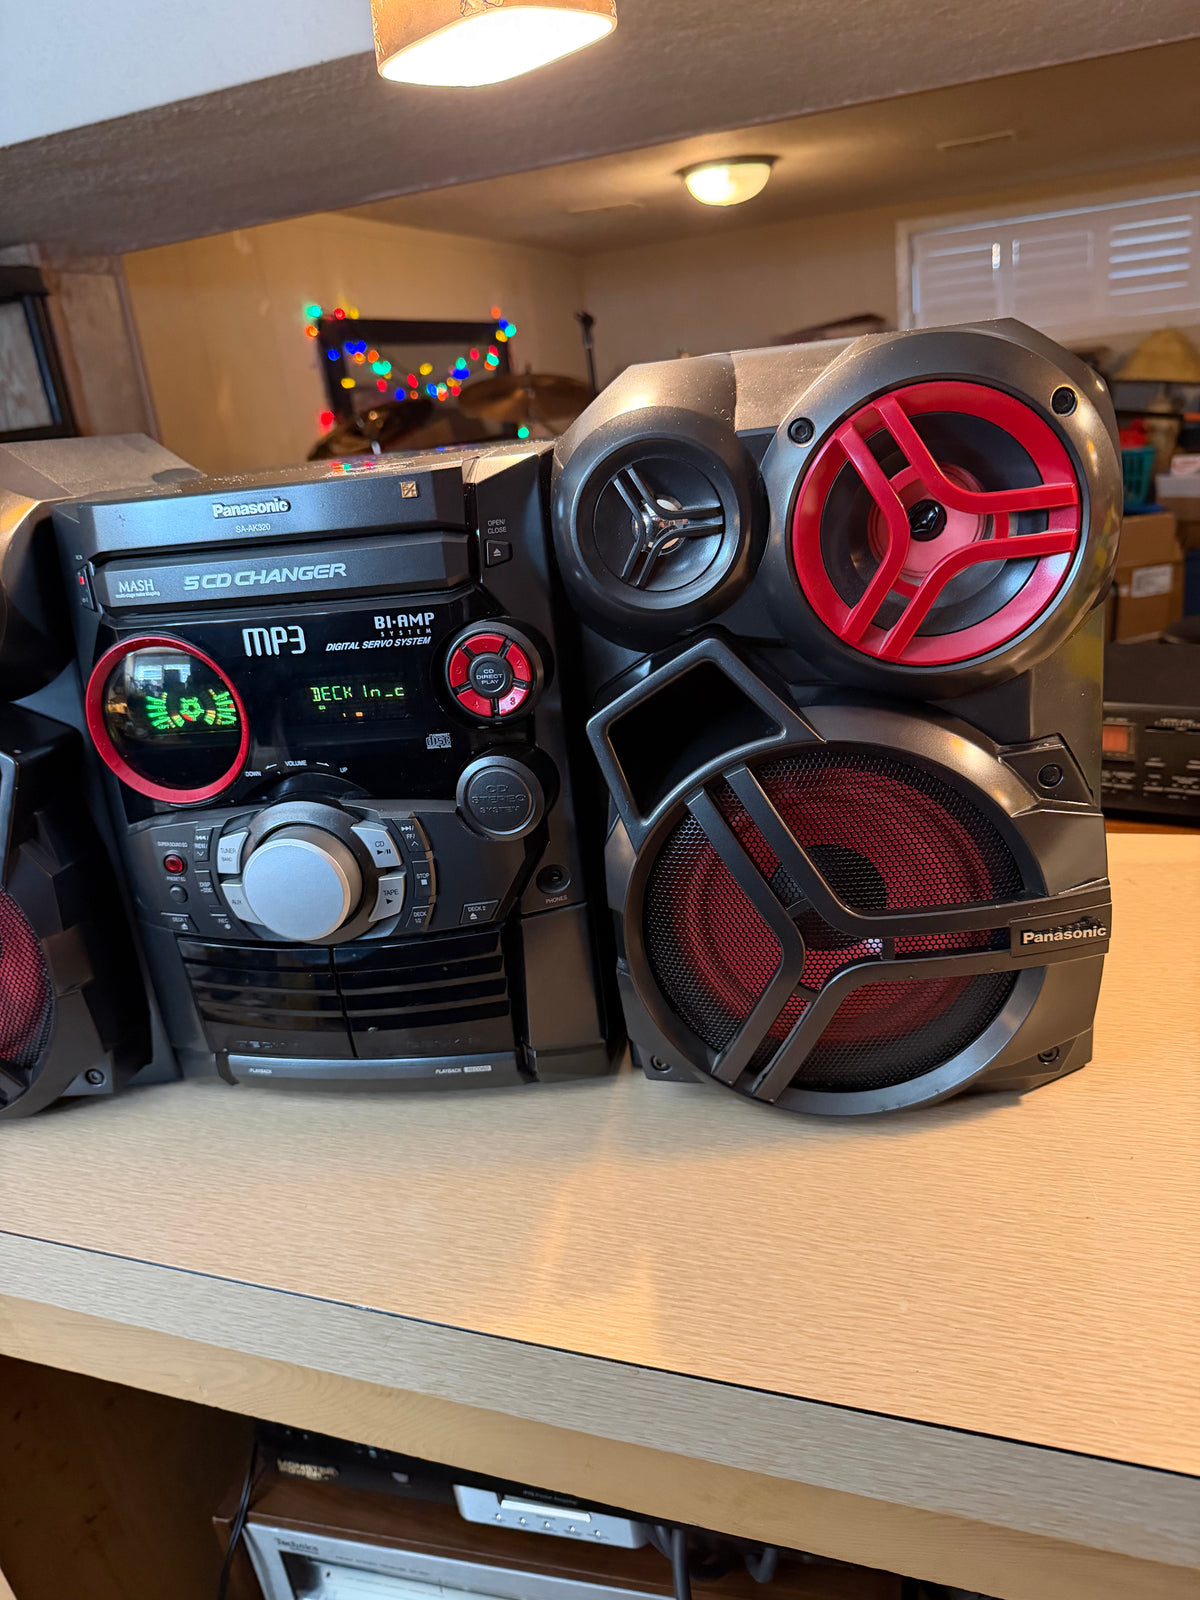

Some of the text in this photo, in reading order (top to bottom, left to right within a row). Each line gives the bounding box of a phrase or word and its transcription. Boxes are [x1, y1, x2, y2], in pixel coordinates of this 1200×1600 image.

[212, 498, 289, 518] Panasonic
[235, 523, 271, 533] SA-AK320
[487, 526, 507, 534] CLOSE
[234, 562, 347, 585] CHANGER
[119, 579, 155, 593] MASH
[381, 628, 432, 637] SYSTEM
[242, 625, 306, 656] MP3
[325, 636, 431, 652] DIGITAL SERVO SYSTEM
[310, 686, 353, 702] DECK
[383, 888, 400, 896] TAPE
[545, 895, 568, 904] PHONES
[1022, 926, 1107, 944] Panasonic
